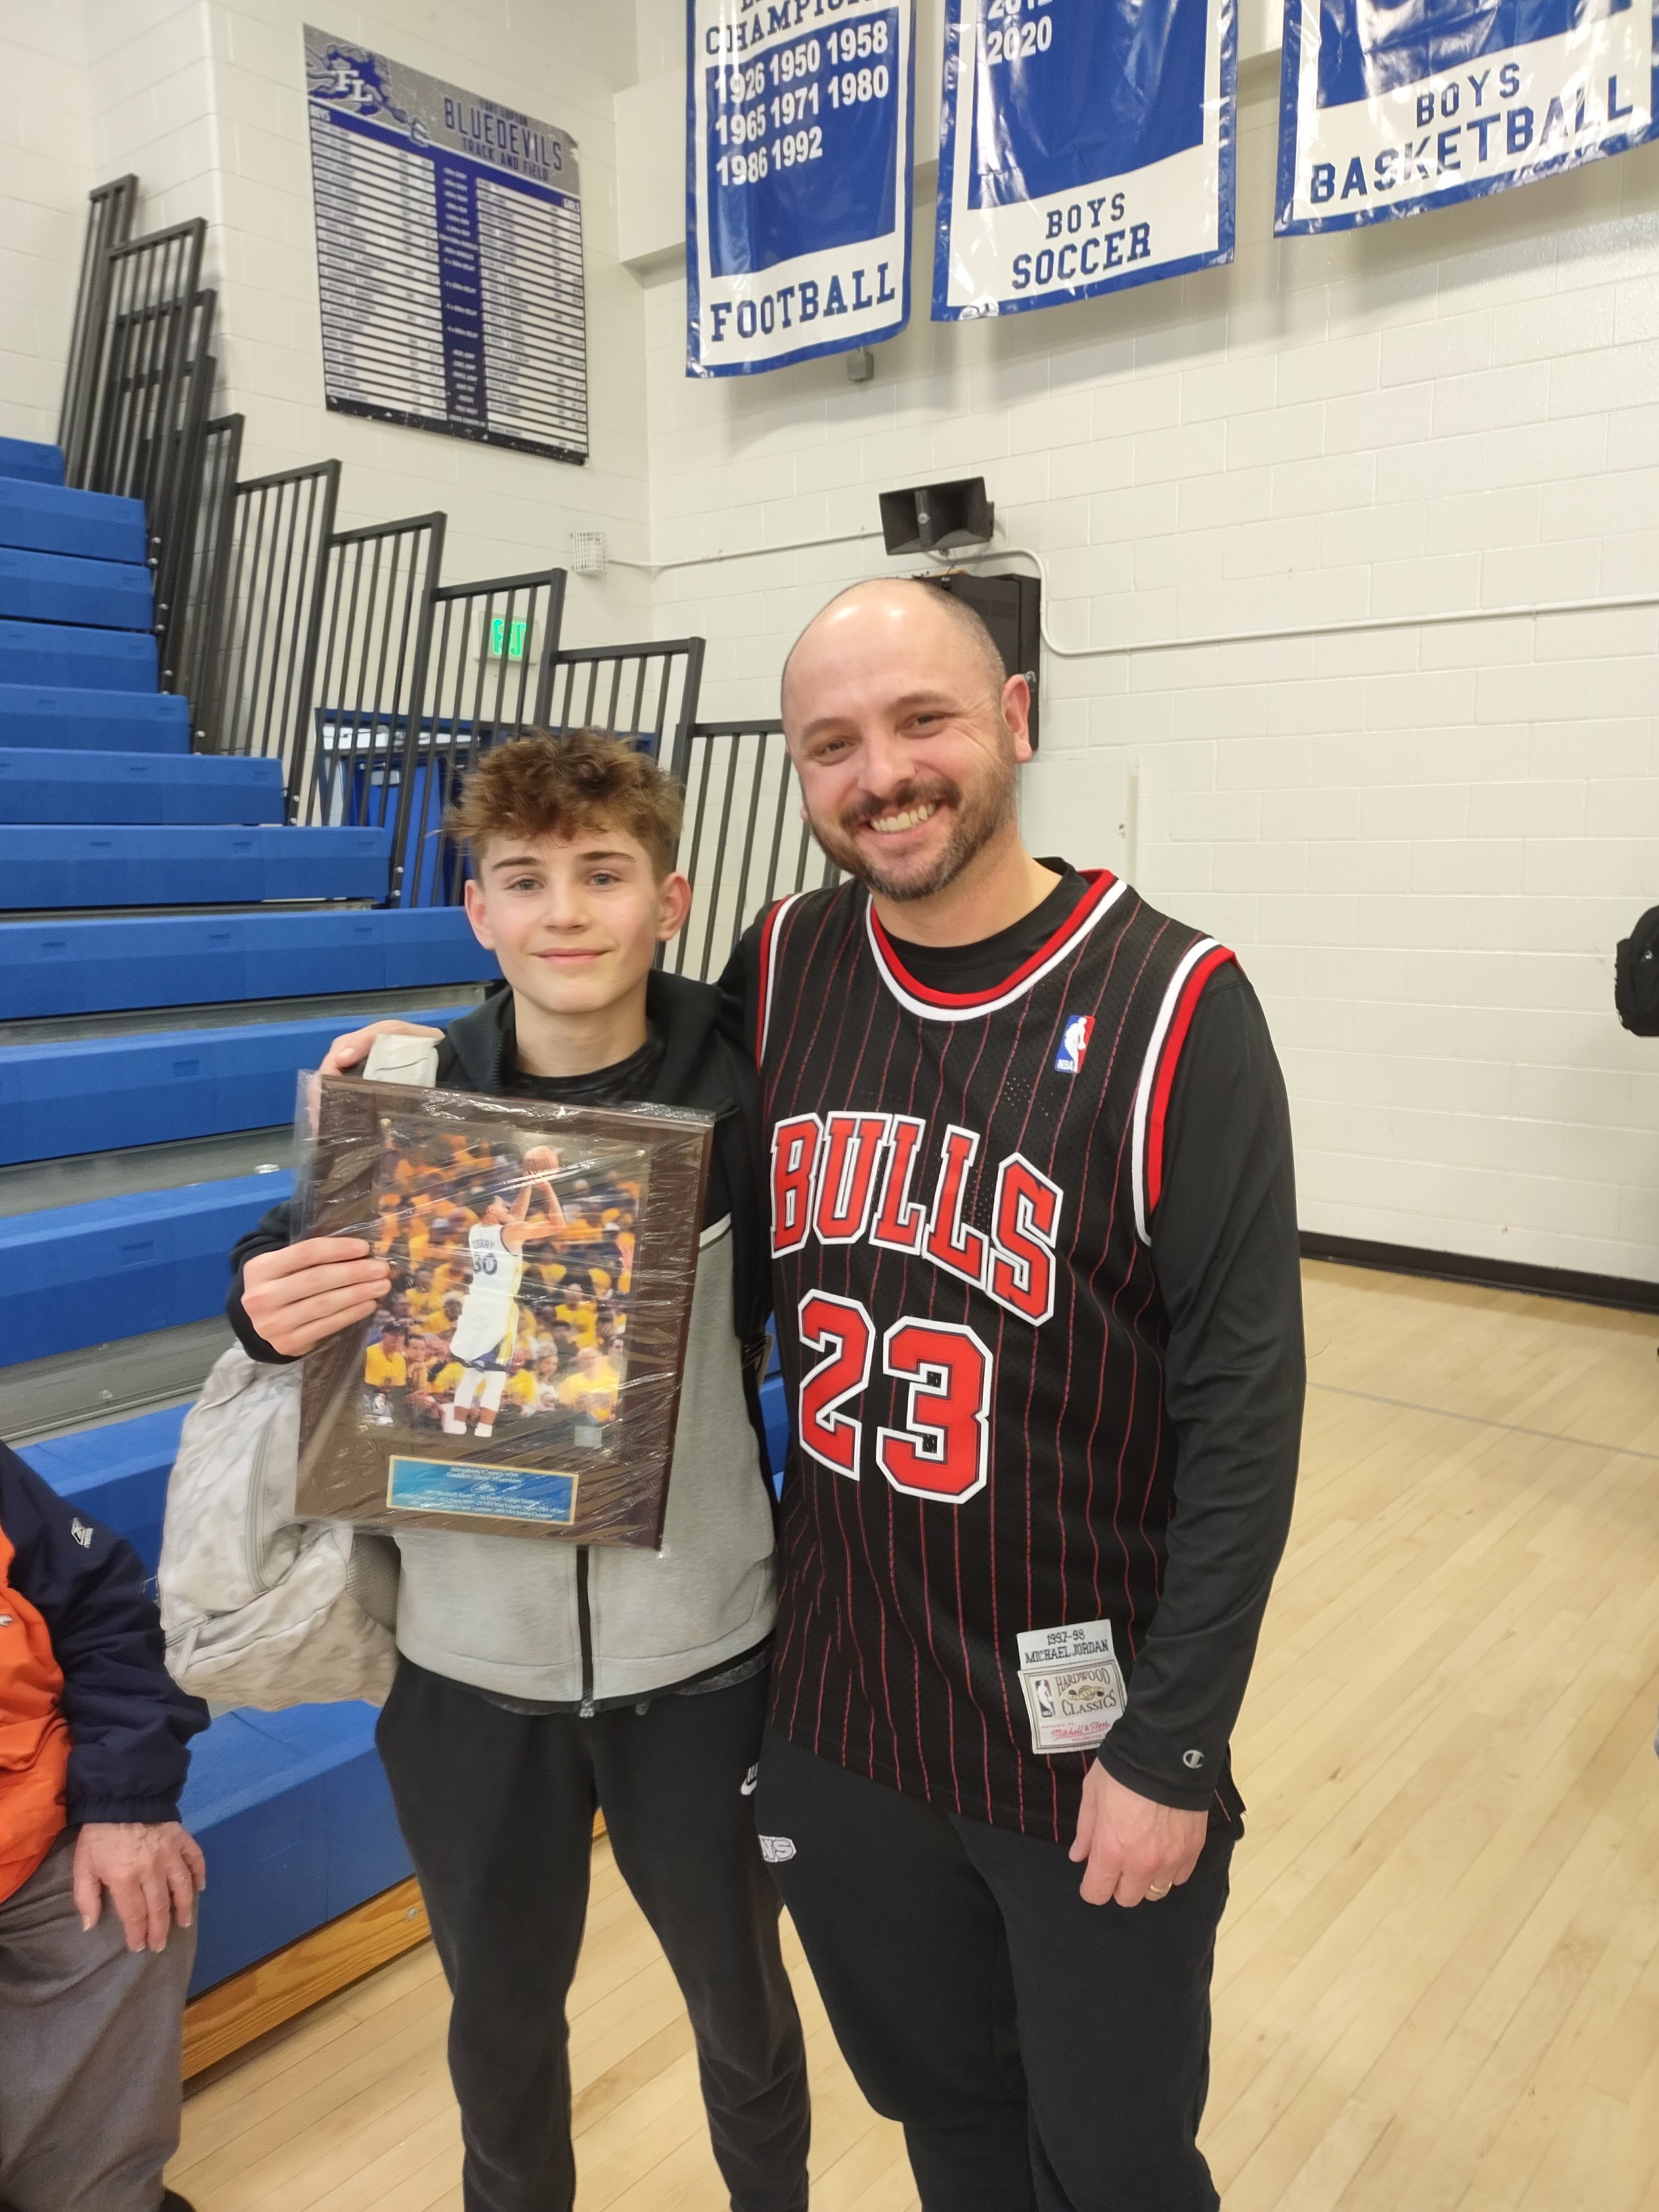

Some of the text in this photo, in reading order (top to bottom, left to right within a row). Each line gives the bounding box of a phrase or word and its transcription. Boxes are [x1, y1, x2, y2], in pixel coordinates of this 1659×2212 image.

[715, 20, 888, 104] 1926 1950 1958
[987, 16, 1052, 65] 2020
[715, 65, 889, 145] 1965 1971 1980
[1416, 62, 1520, 128] BOYS
[444, 98, 563, 171] BLUEDEVILS
[463, 137, 548, 181] TRACK AND FIELD
[716, 126, 823, 186] 1986 1992
[1310, 74, 1634, 204] BASKETBALL
[1045, 192, 1125, 240] BOYS
[1012, 222, 1151, 290] SOCCER
[710, 261, 896, 342] FOOTBALL
[770, 1110, 1064, 1327] BULLS
[797, 1288, 993, 1506] 23
[1025, 1639, 1109, 1663] MICHAEL JORDAN
[1046, 1629, 1086, 1645] 1997-98
[1054, 1667, 1111, 1696] HARDWOOD
[1062, 1689, 1117, 1716] CLASSICS
